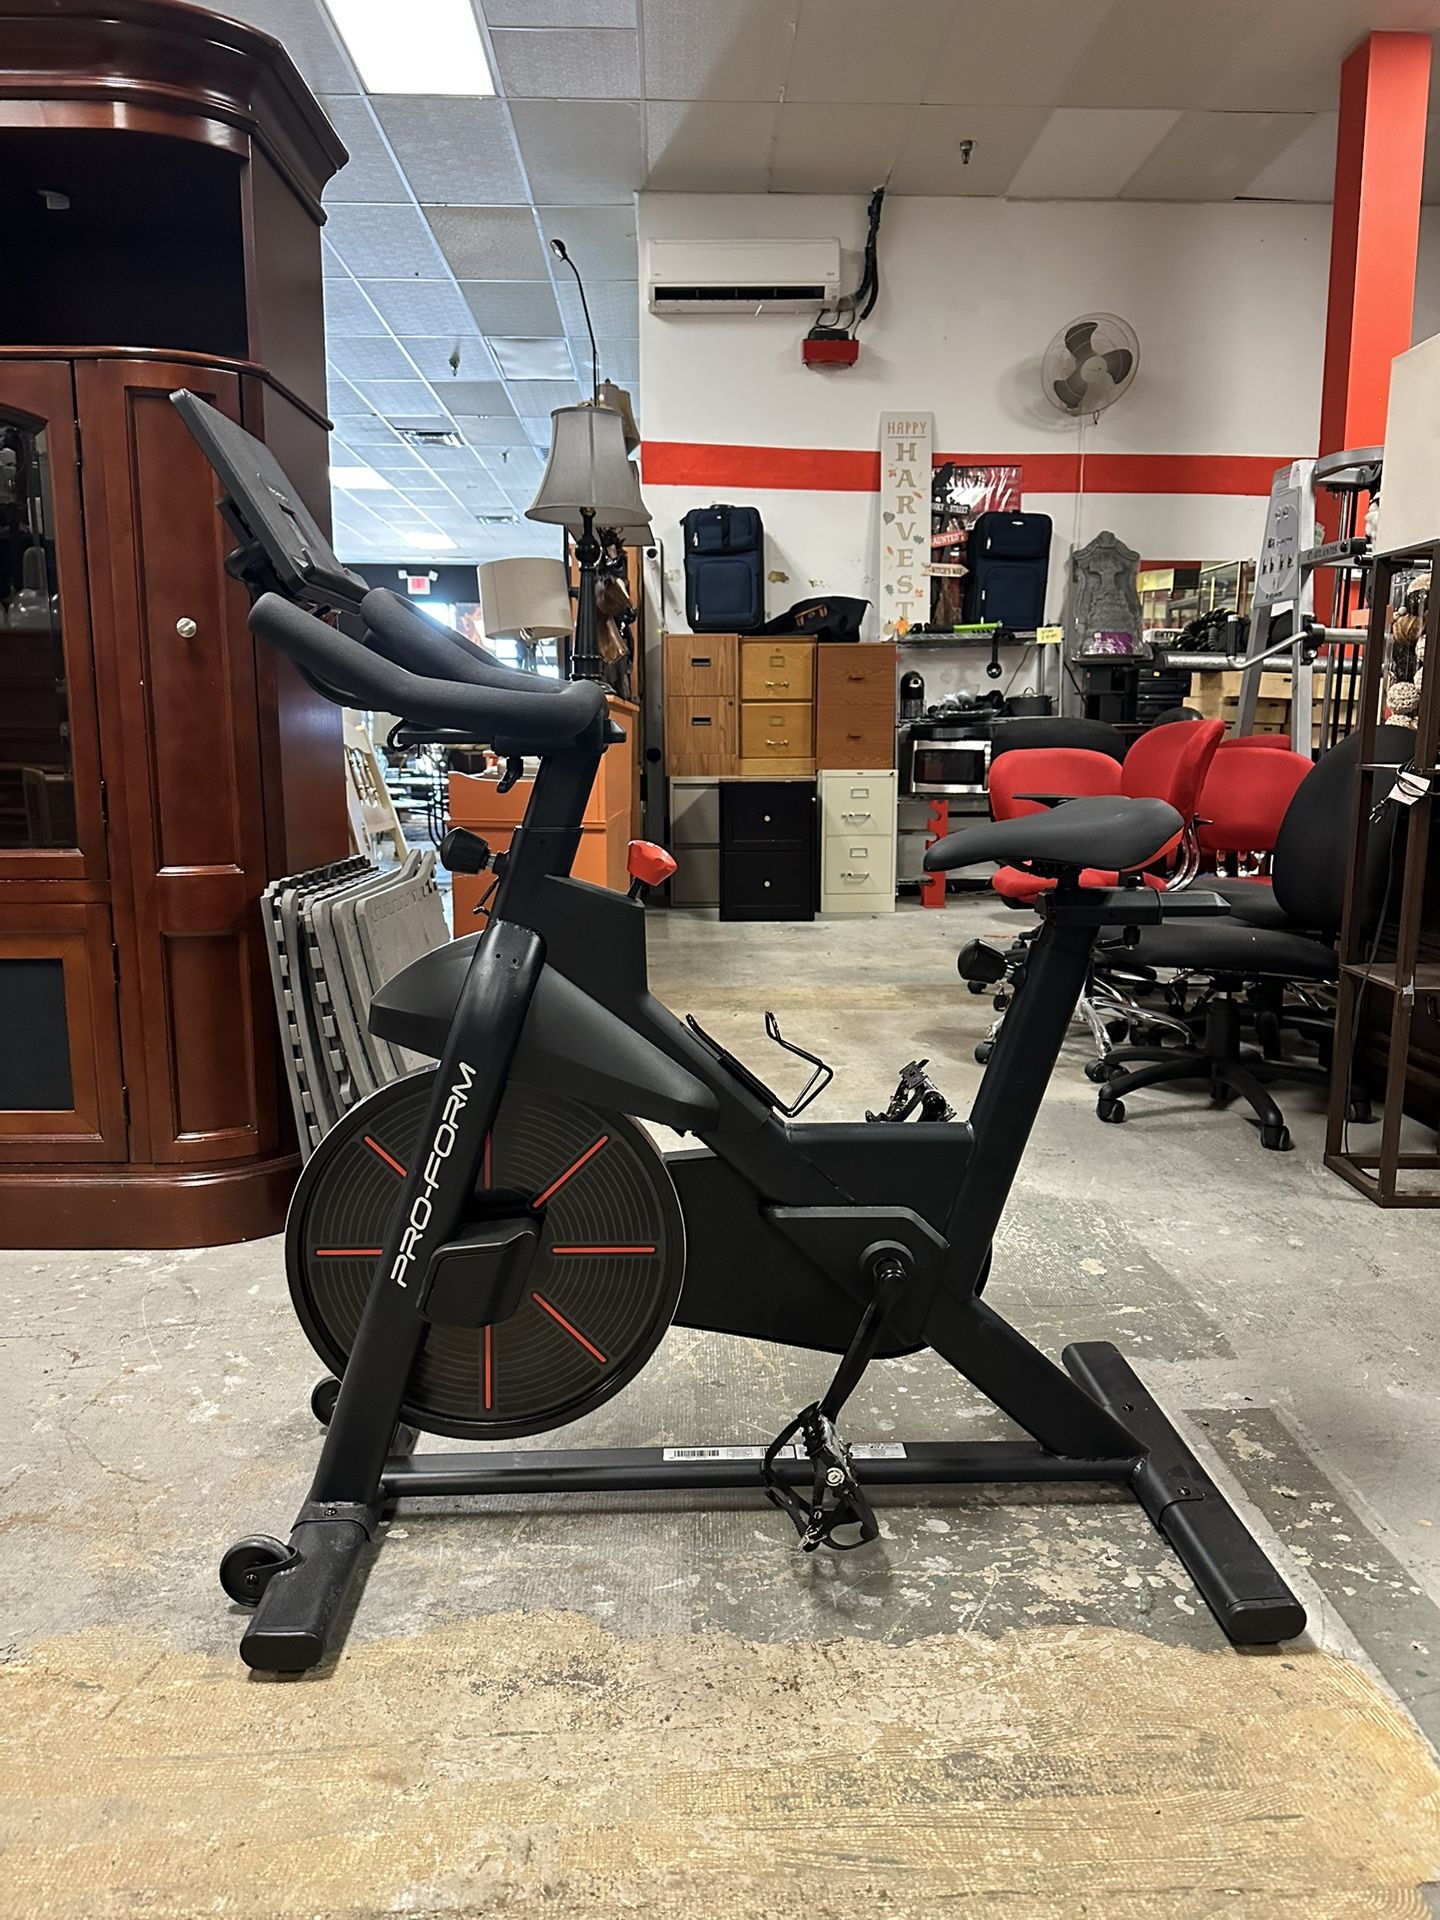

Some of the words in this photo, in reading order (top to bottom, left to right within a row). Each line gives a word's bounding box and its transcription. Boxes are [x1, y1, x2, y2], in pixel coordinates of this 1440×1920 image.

[887, 421, 926, 434] HAPPY
[895, 442, 917, 619] HARVEST
[932, 532, 959, 545] AUNTED
[390, 1061, 477, 1288] PRO-FORM
